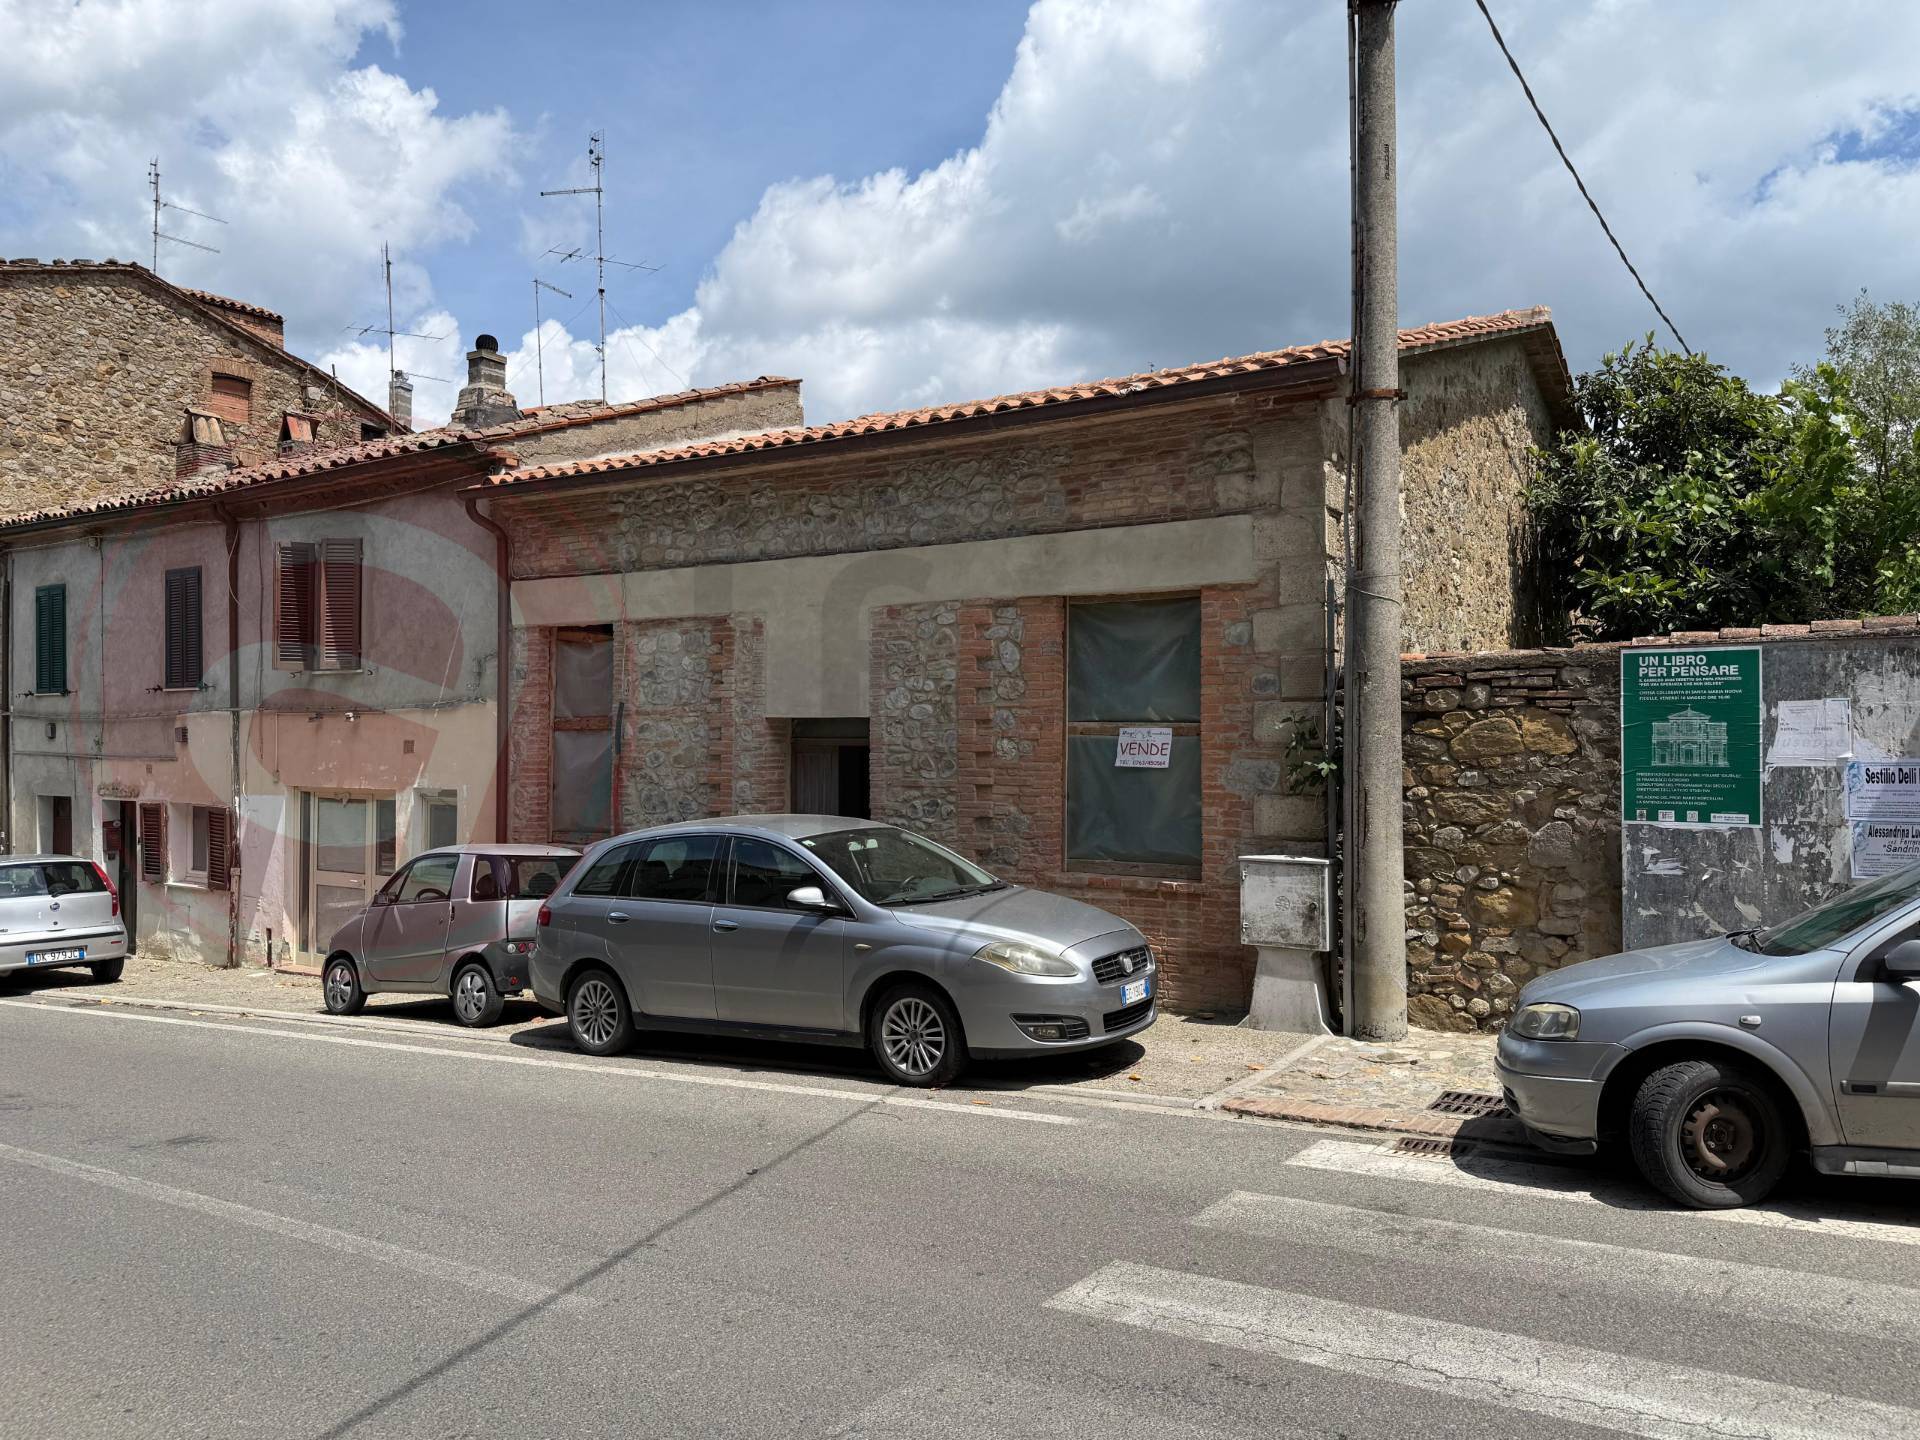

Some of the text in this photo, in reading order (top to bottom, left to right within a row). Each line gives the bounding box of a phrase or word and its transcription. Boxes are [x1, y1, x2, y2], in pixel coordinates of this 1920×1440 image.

[1638, 655, 1706, 666] UN LIBRO
[1638, 665, 1739, 677] PER PENSARE
[1120, 742, 1170, 756] VENDE
[1865, 768, 1896, 784] Sestilio
[1898, 768, 1917, 784] Delli
[1868, 824, 1909, 838] Alessandrina
[51, 950, 78, 960] 979JC
